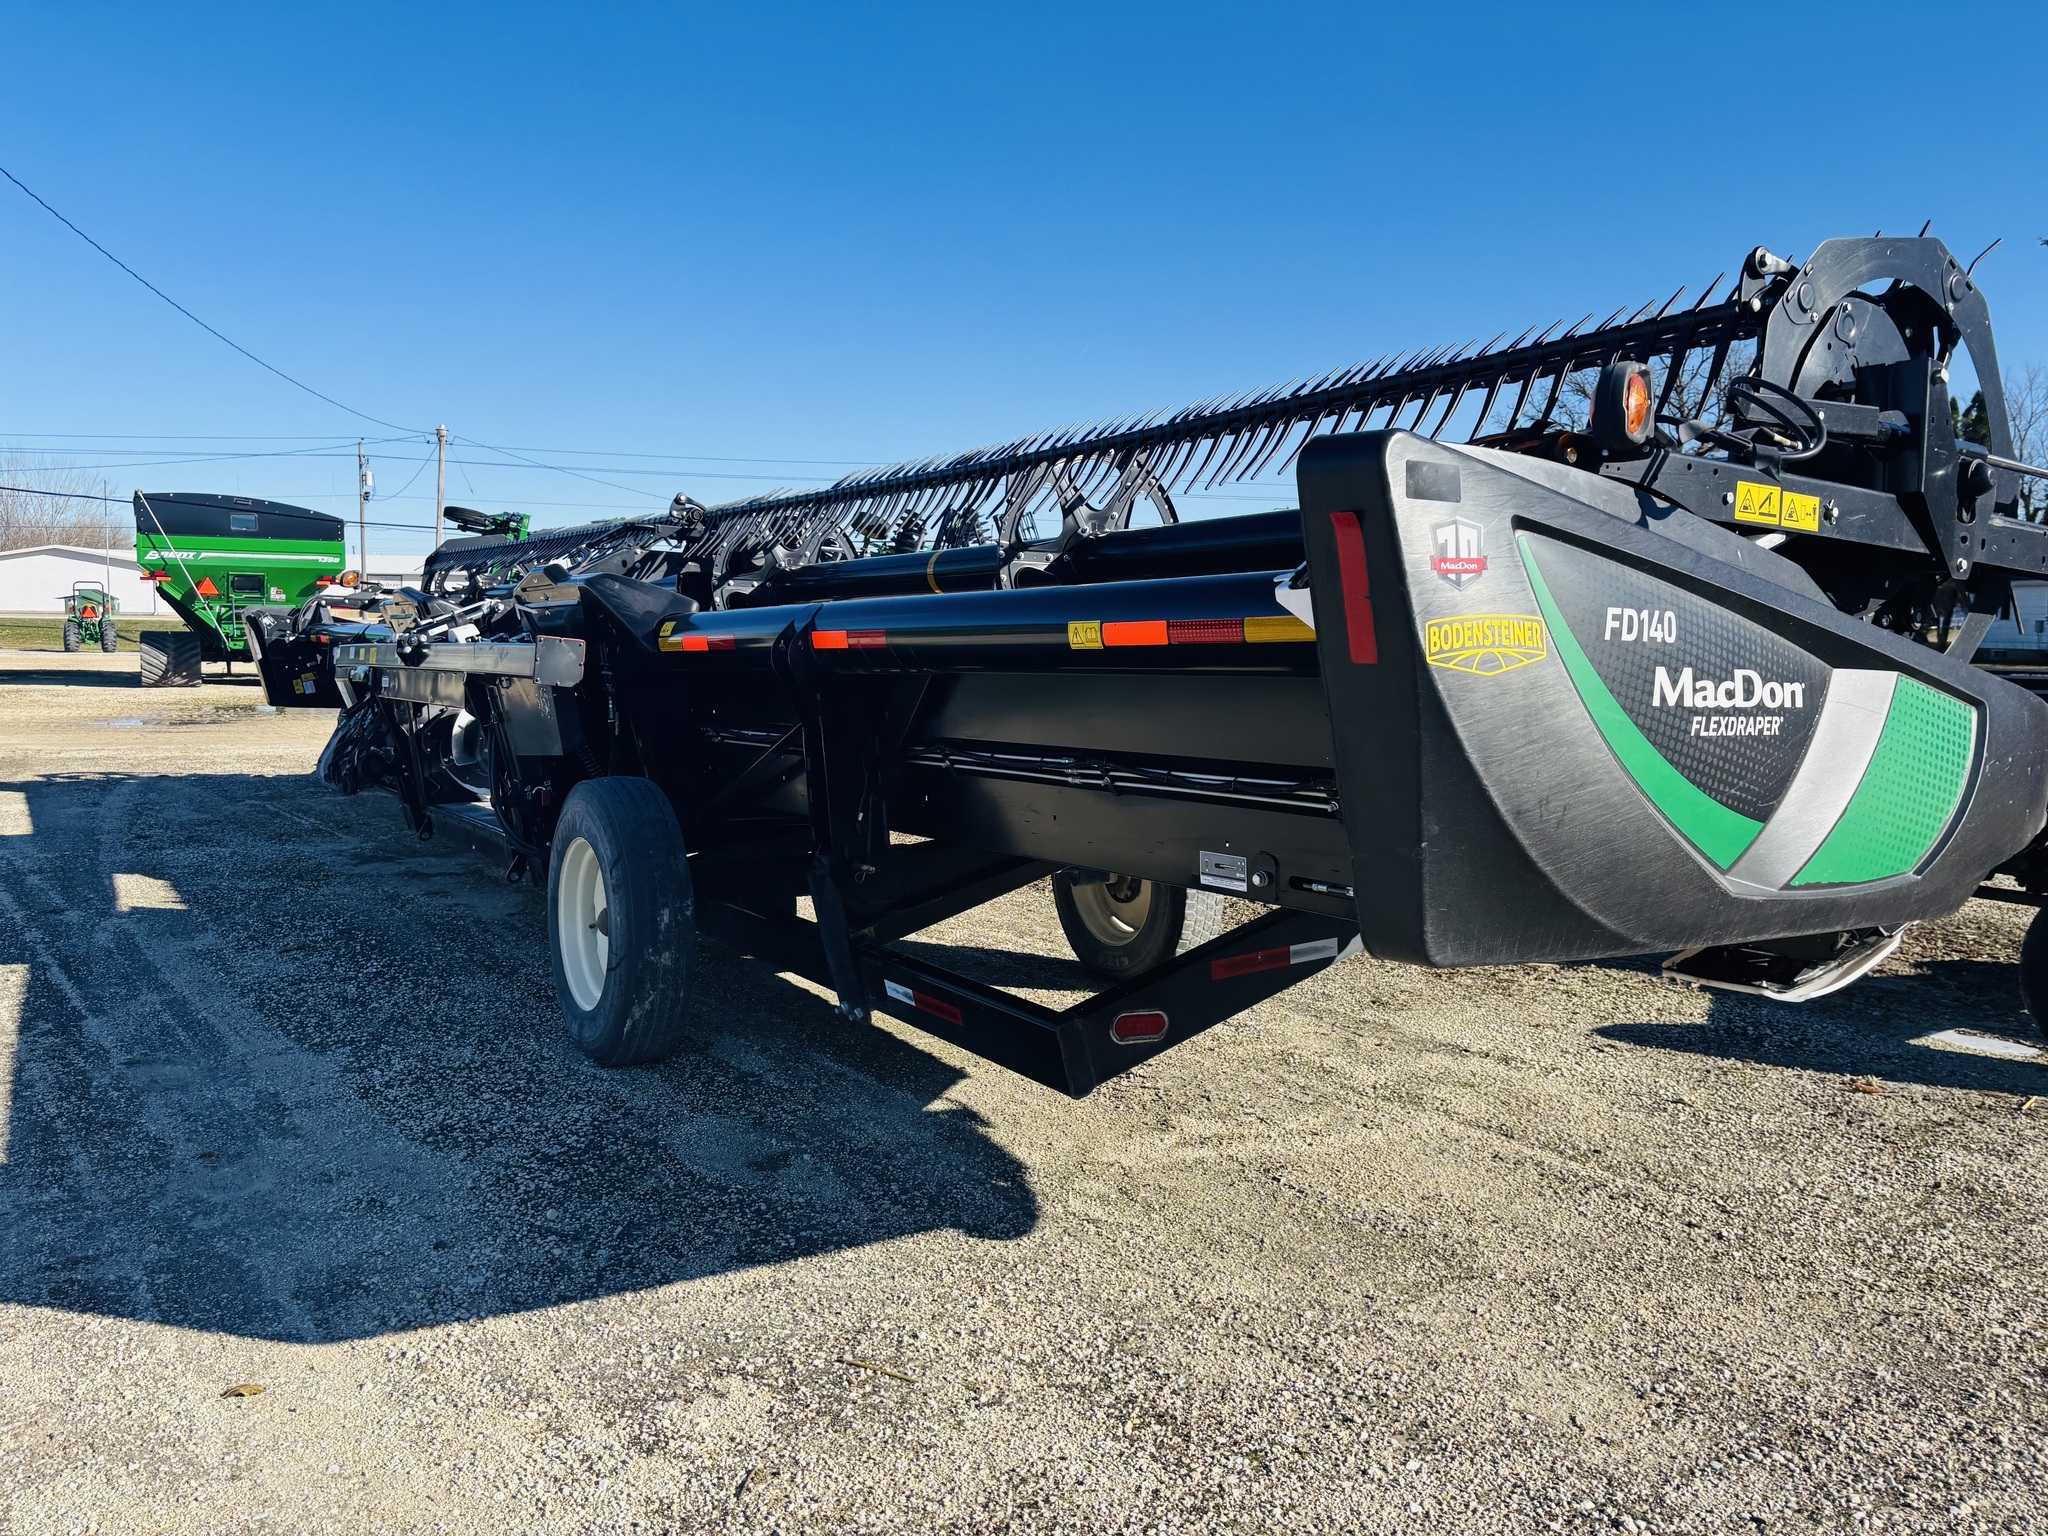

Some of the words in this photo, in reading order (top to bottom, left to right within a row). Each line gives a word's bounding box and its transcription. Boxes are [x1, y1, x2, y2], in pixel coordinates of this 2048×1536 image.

[1440, 561, 1478, 570] MacDon
[1430, 619, 1543, 653] BODENSTEINER
[1604, 607, 1677, 643] FD140
[1652, 666, 1805, 708] MacDon
[1690, 716, 1783, 737] FLEXDRAPER
